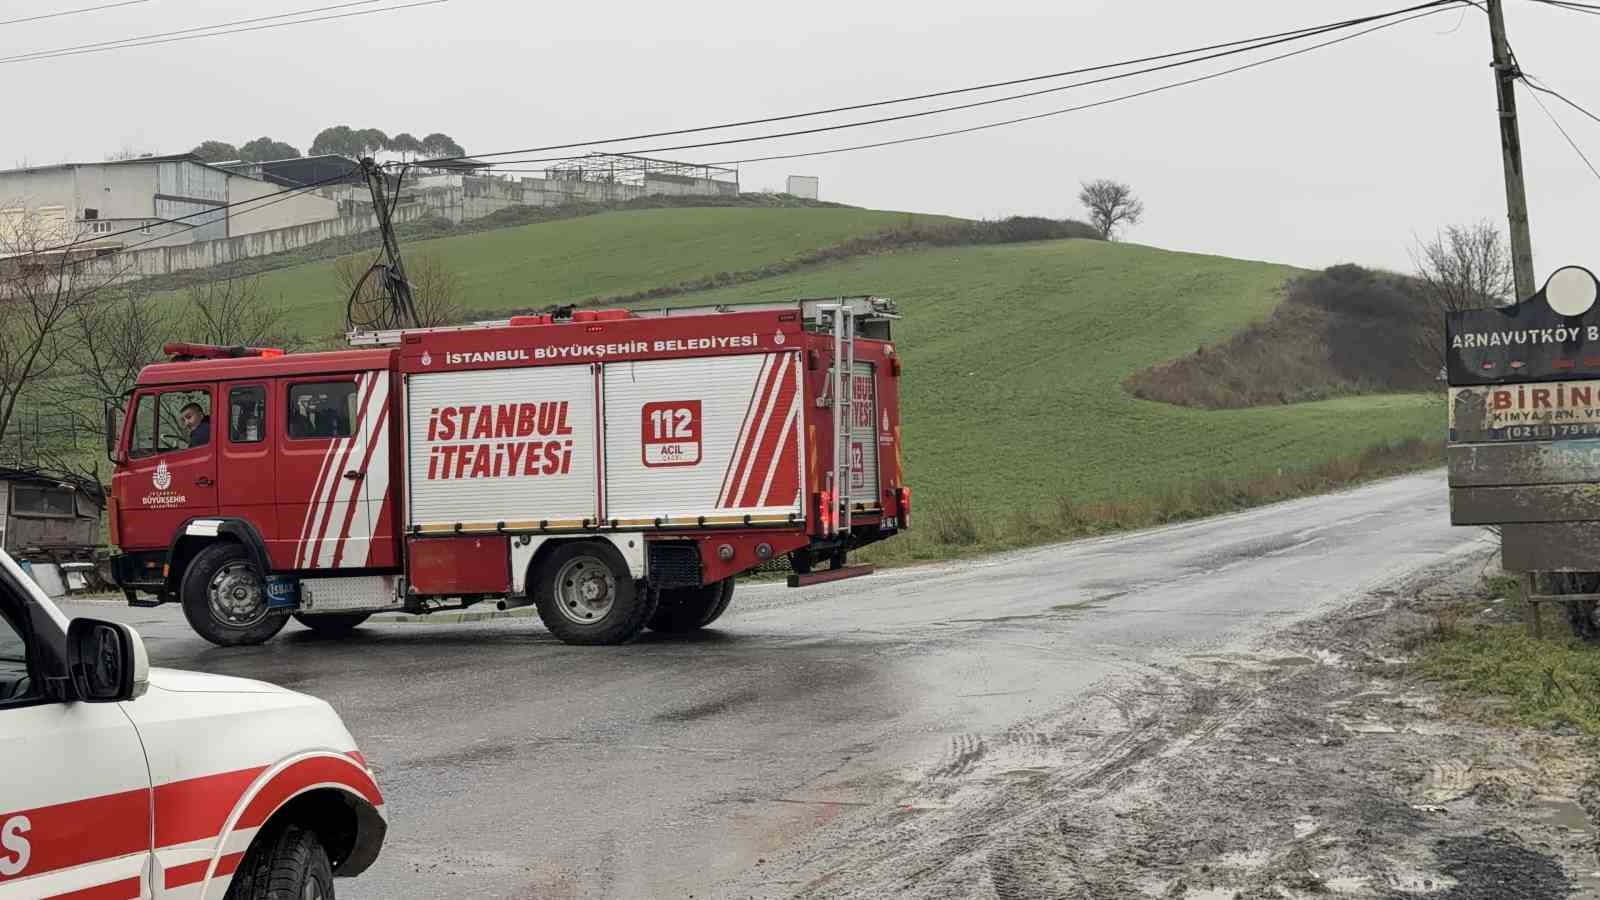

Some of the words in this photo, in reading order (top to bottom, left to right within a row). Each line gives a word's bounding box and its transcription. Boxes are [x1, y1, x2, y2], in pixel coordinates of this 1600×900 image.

[446, 350, 529, 364] İSTANBUL
[534, 340, 648, 357] BÜYÜKŞEHİR
[654, 333, 758, 351] BELEDİYESİ
[1452, 323, 1580, 349] ARNAVUTKÖY
[1493, 384, 1600, 409] BİRİN
[651, 408, 693, 439] 112
[0, 815, 32, 876] S
